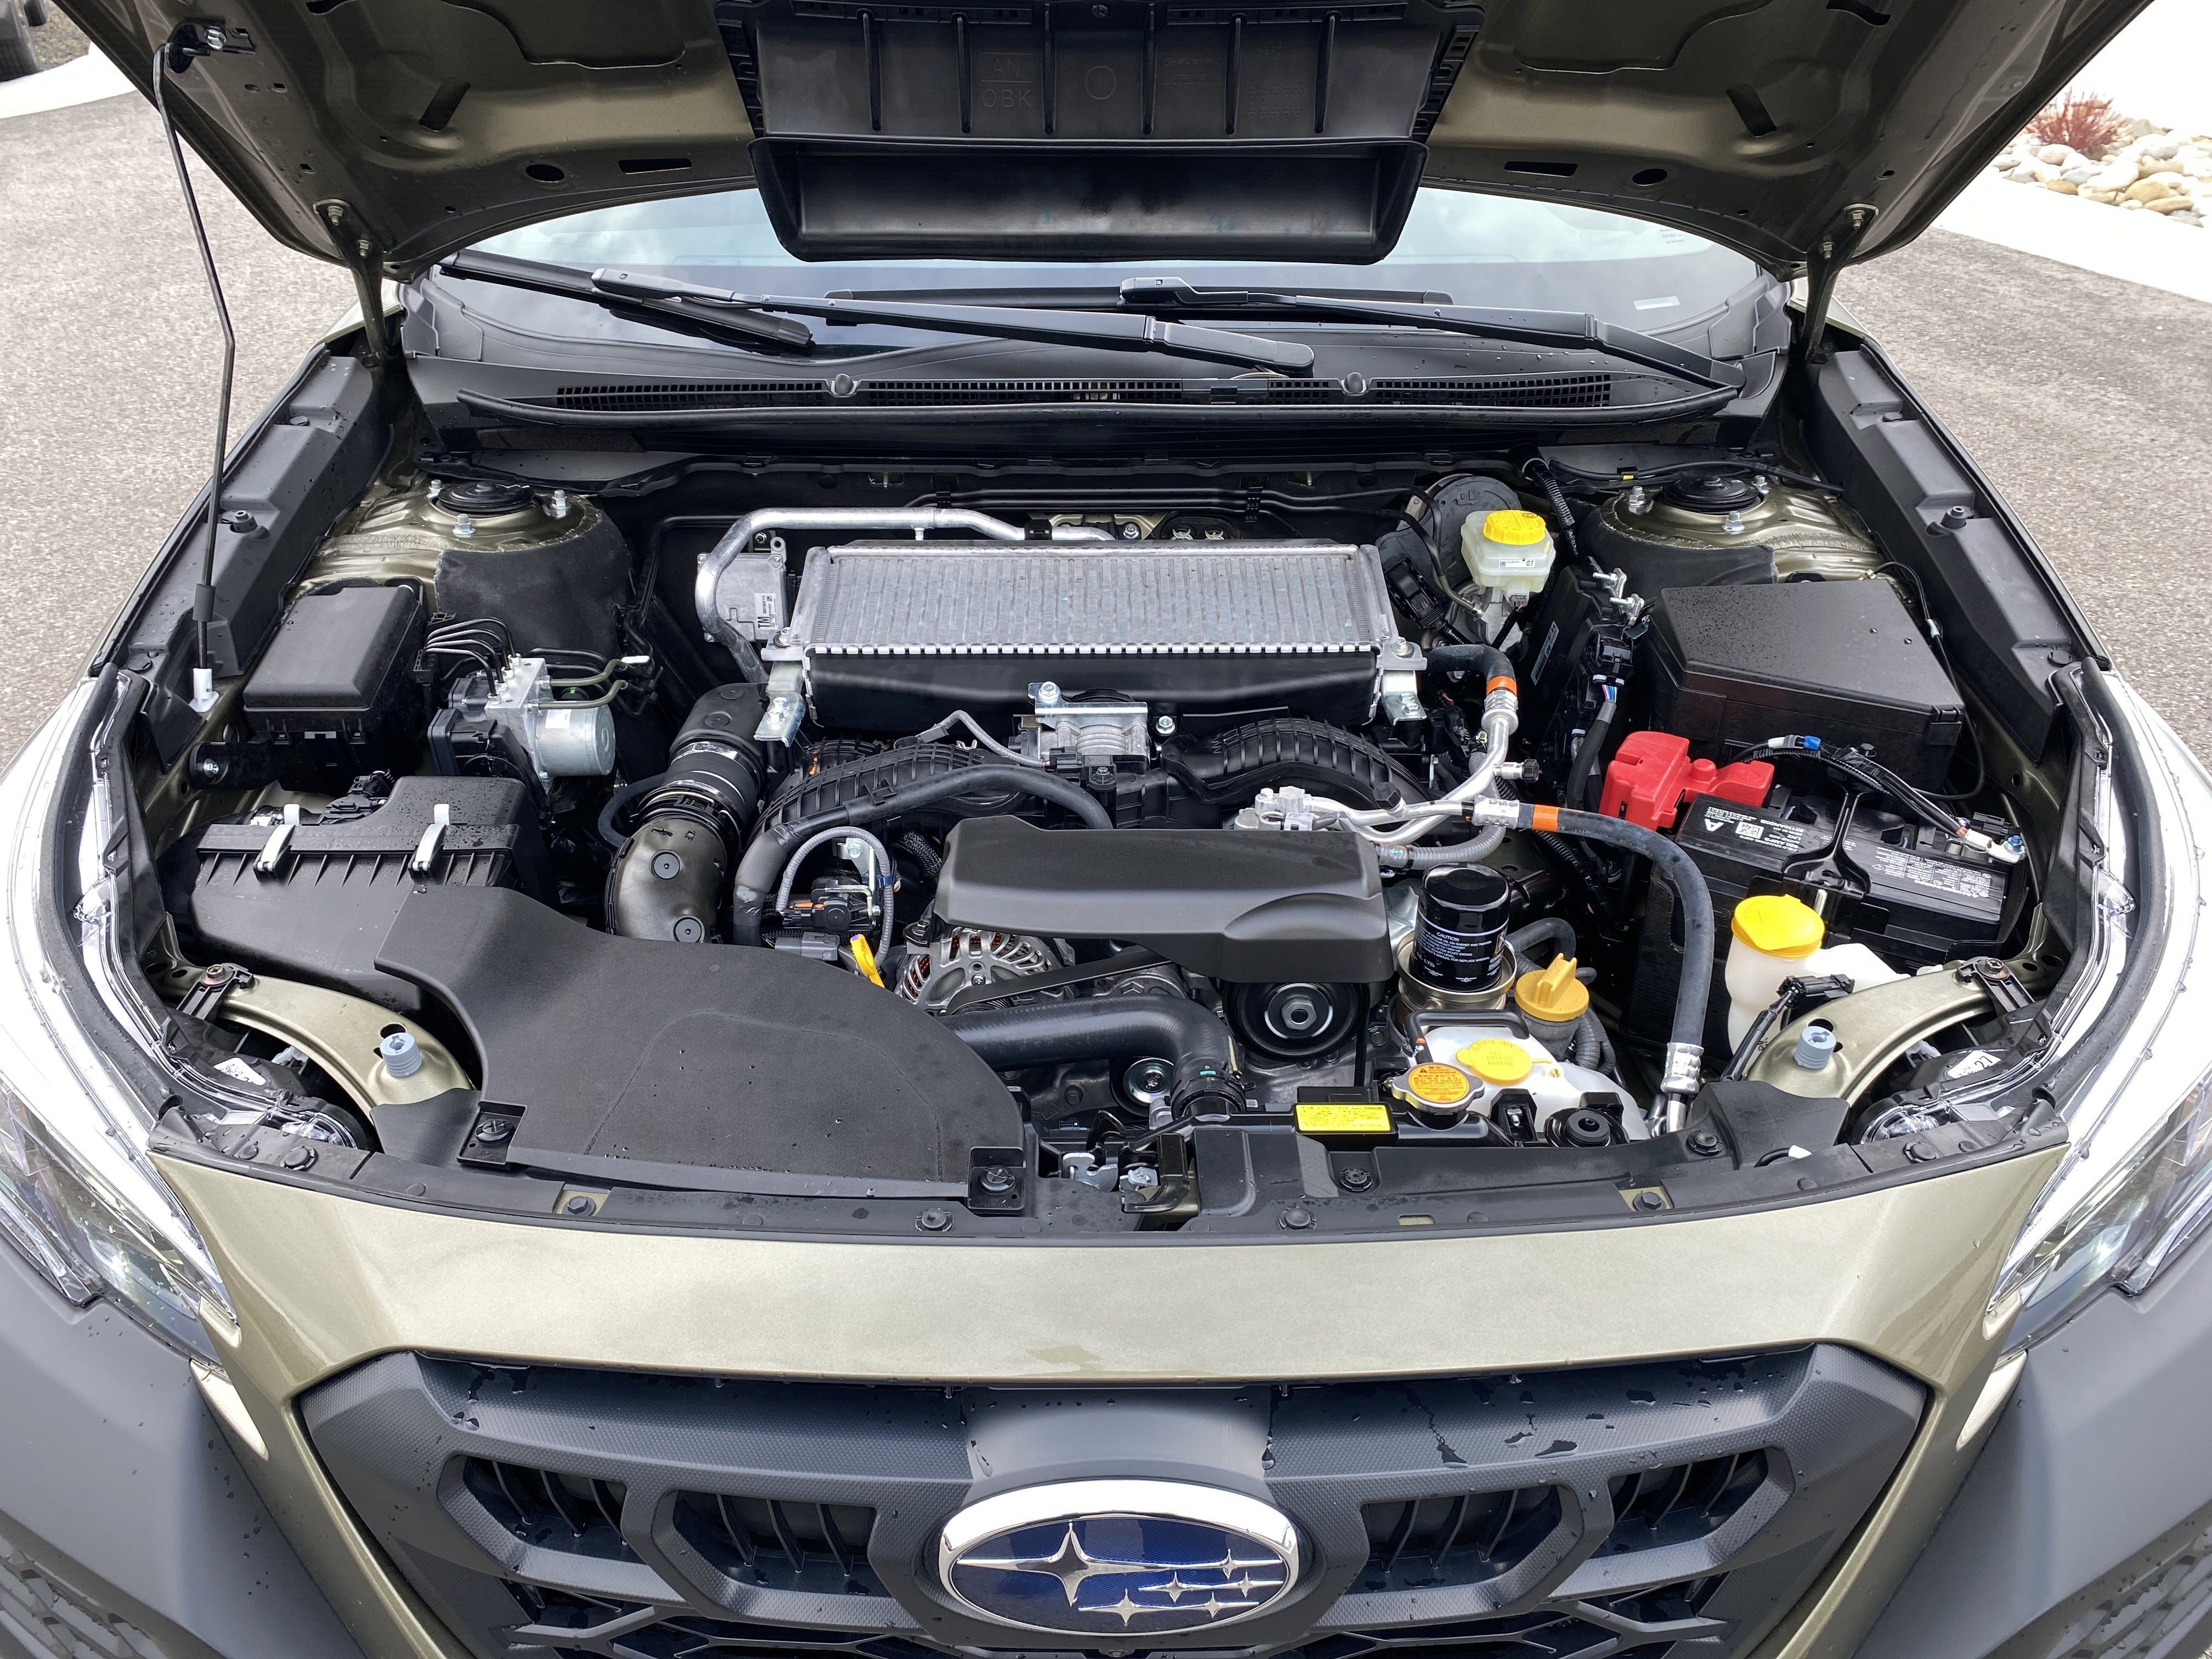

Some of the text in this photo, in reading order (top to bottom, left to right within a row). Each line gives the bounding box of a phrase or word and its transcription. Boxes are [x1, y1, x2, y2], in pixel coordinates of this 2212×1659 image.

[992, 59, 1020, 78] AN
[983, 88, 1032, 109] OBK
[757, 616, 770, 629] TM
[1436, 932, 1459, 942] CAUTION
